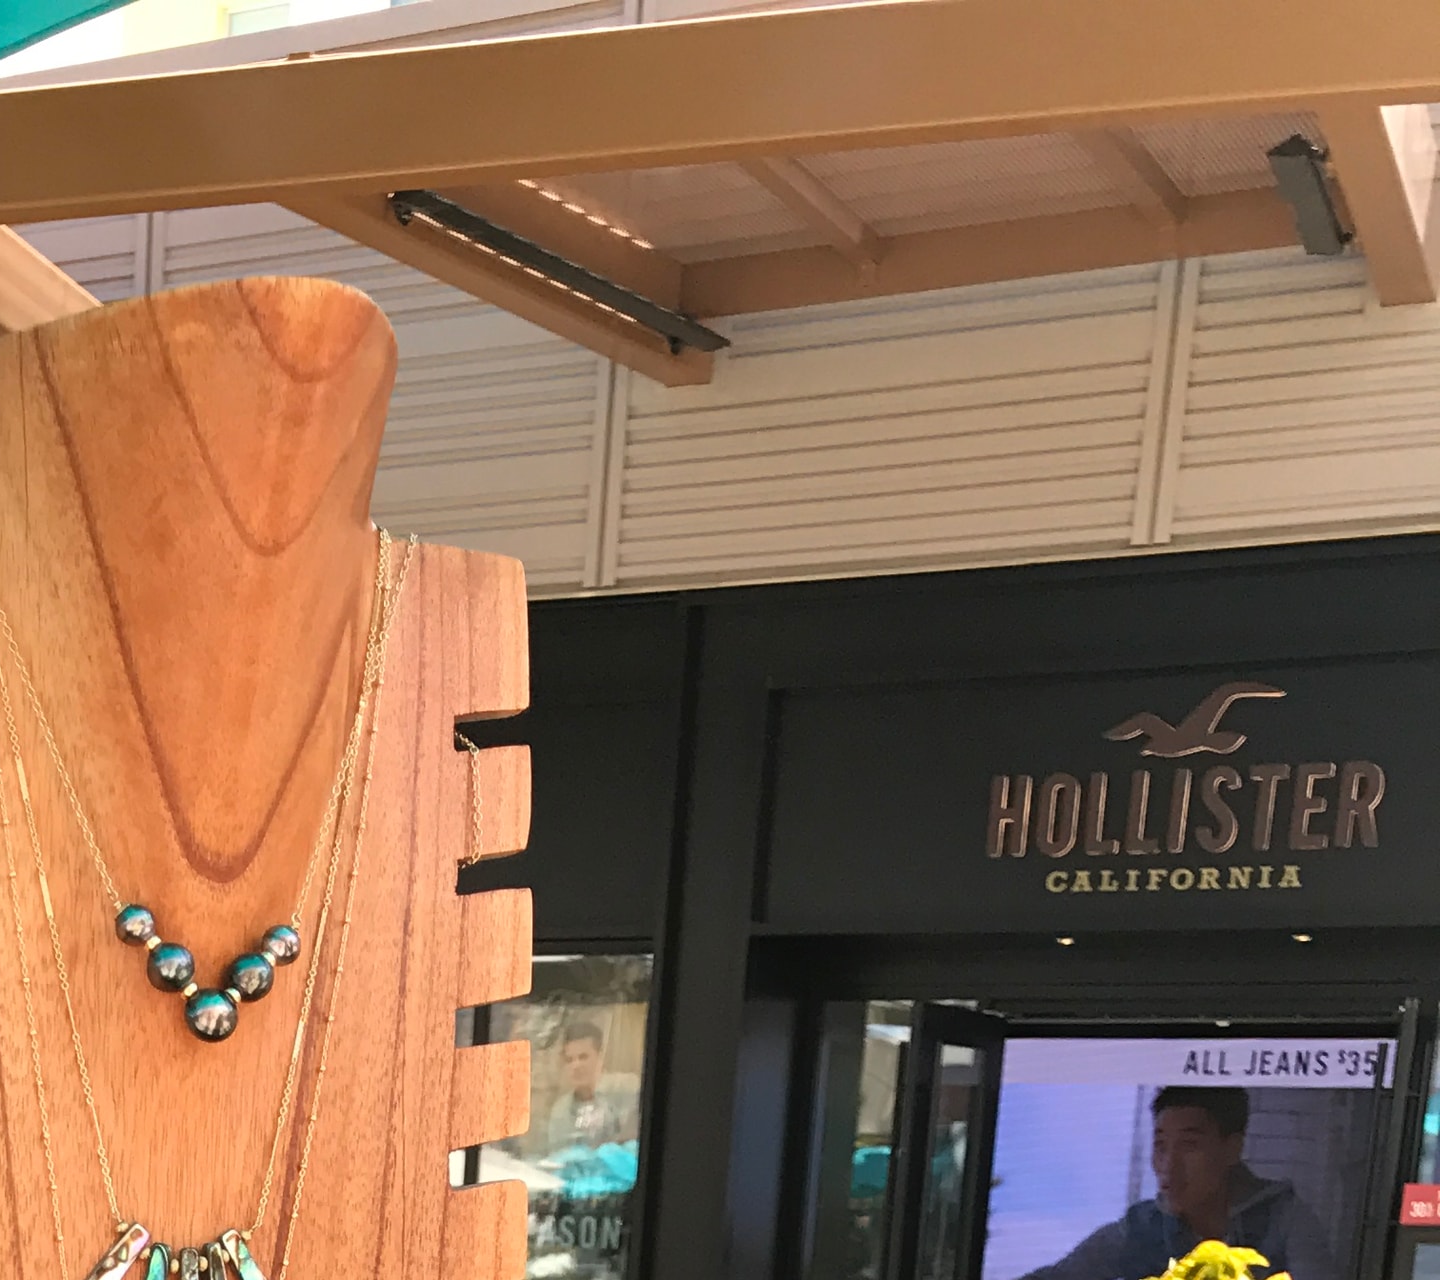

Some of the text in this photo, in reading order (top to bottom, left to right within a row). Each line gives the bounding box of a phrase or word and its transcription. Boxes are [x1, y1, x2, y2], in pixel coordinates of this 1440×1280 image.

[986, 760, 1386, 859] HOLLISTER
[1045, 864, 1303, 894] CALIFORNIA
[1183, 1049, 1378, 1077] ALL JEANS $35
[536, 1213, 624, 1250] ASON
